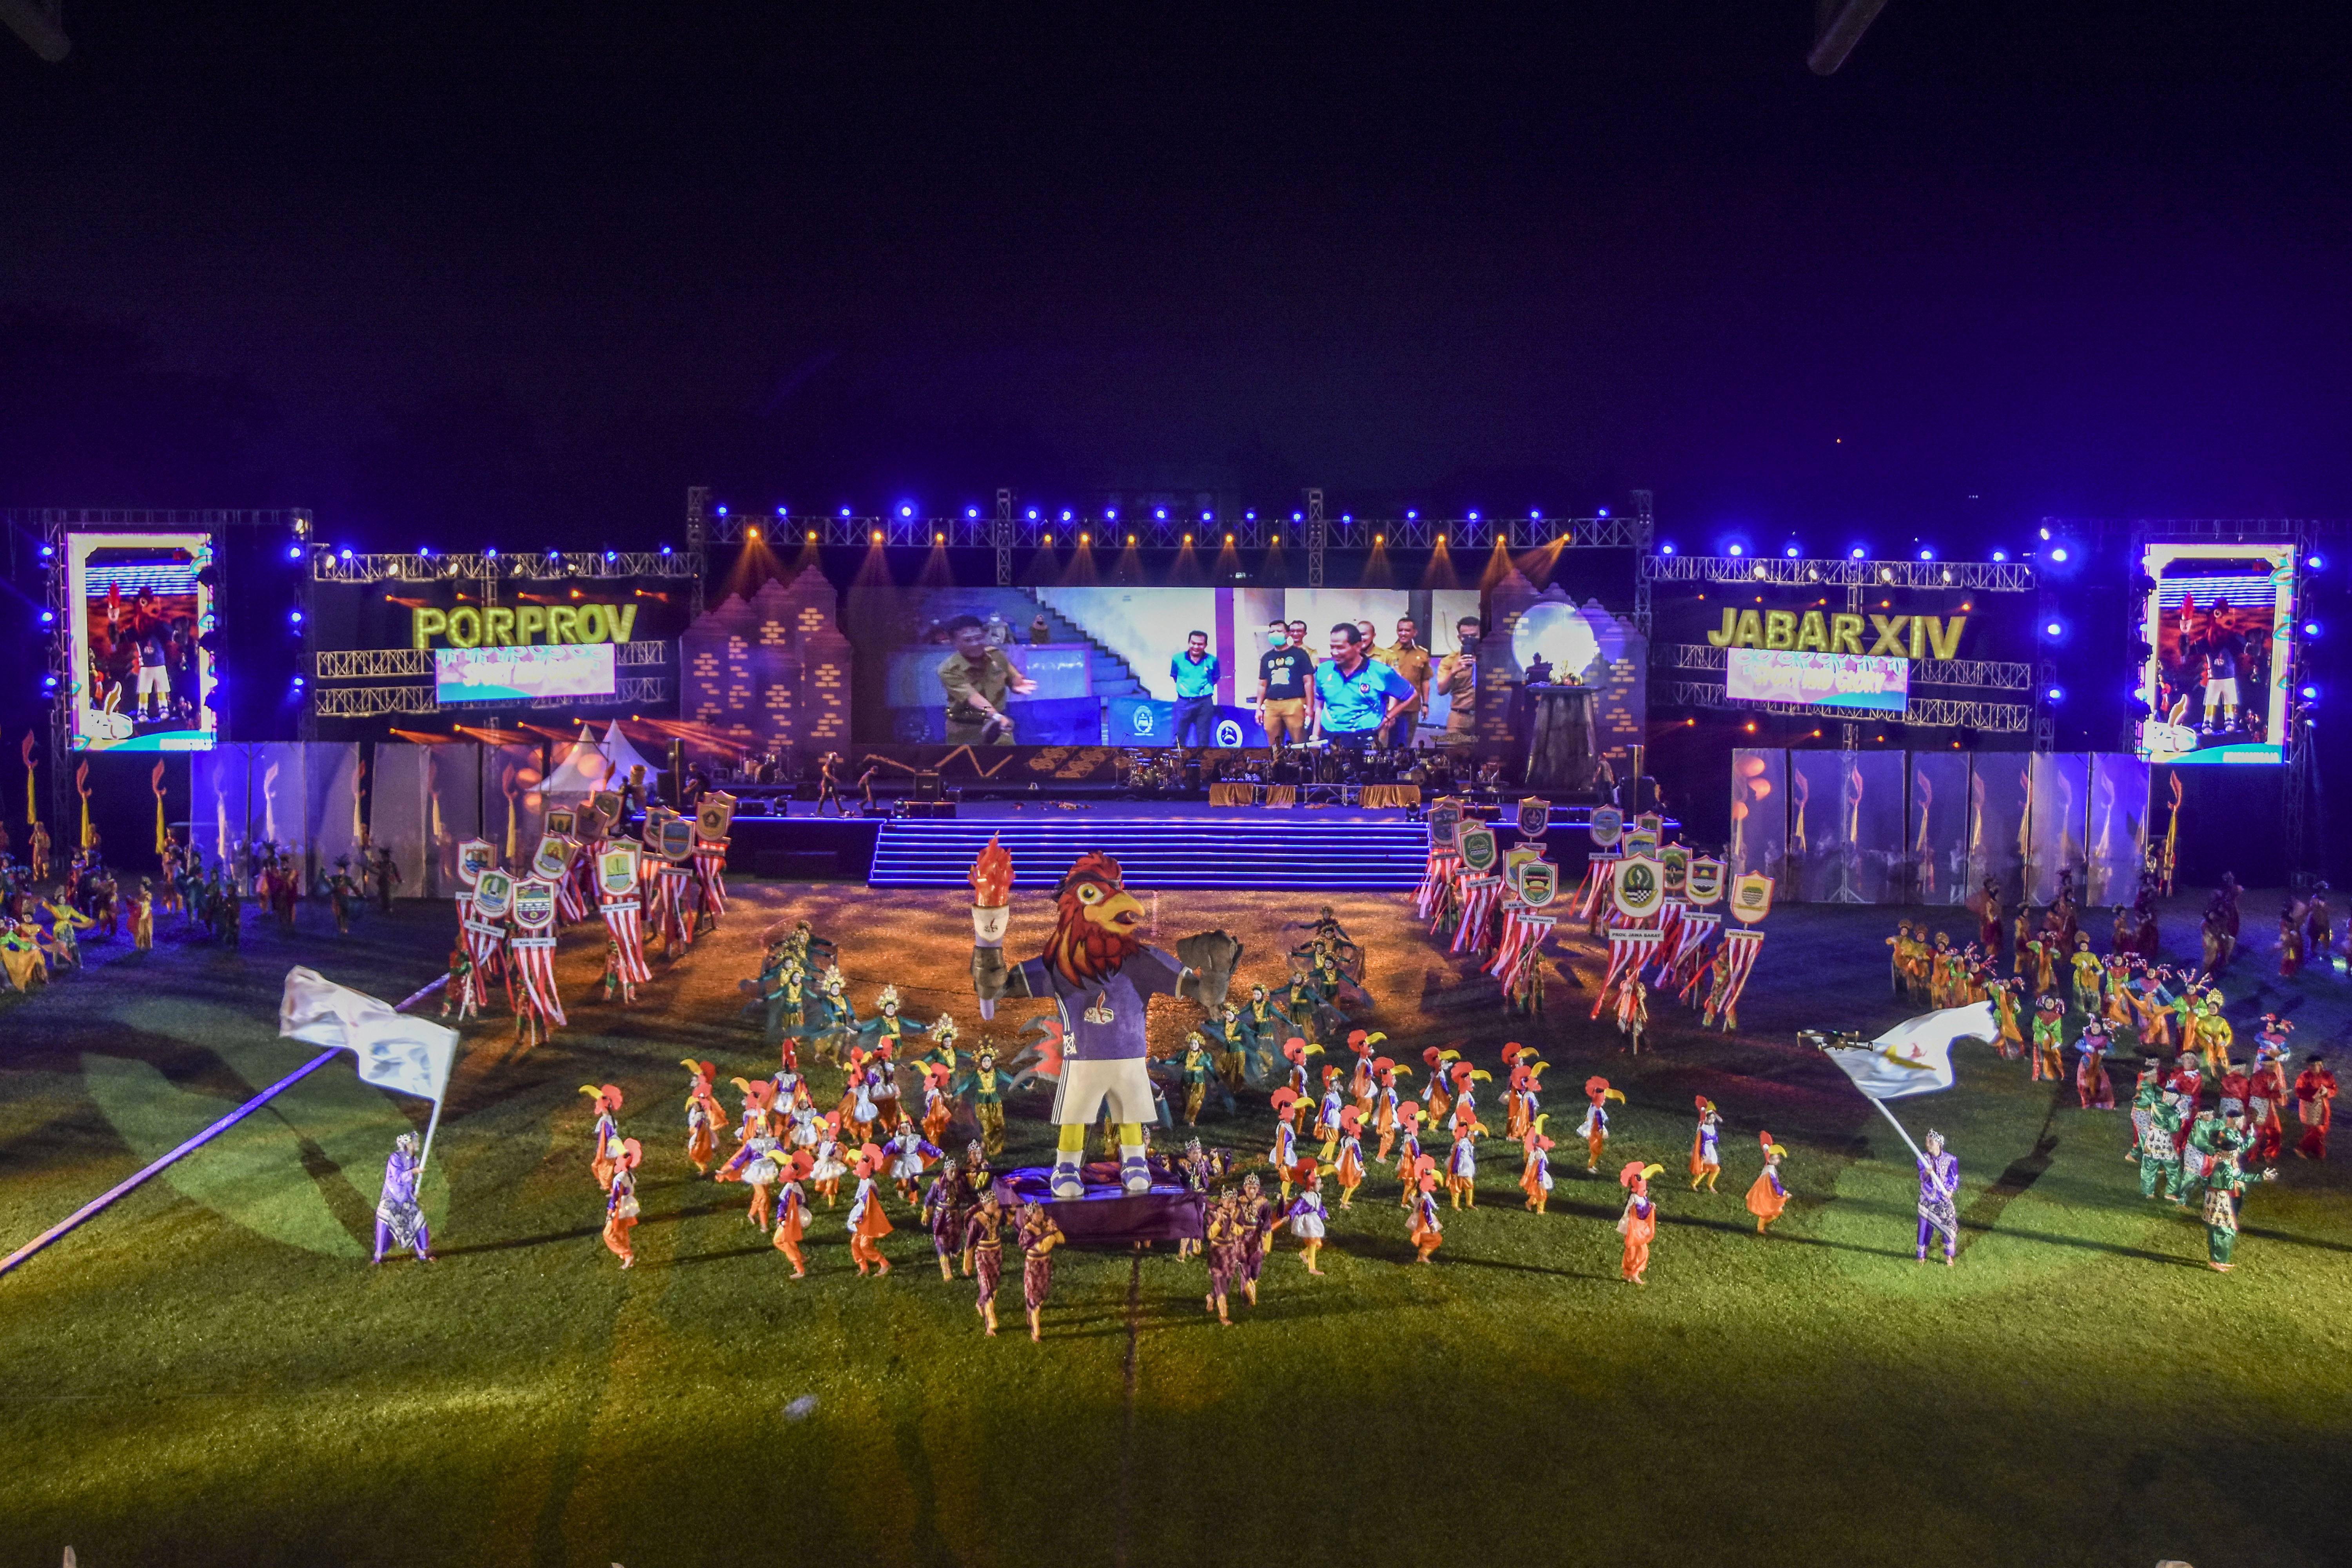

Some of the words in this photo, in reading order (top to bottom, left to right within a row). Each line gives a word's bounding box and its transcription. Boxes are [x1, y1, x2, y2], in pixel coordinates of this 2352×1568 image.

[412, 604, 638, 649] PORPROV
[1707, 607, 1866, 654] JABAR
[1867, 614, 1967, 660] XIV
[1835, 668, 1886, 694] GLORY
